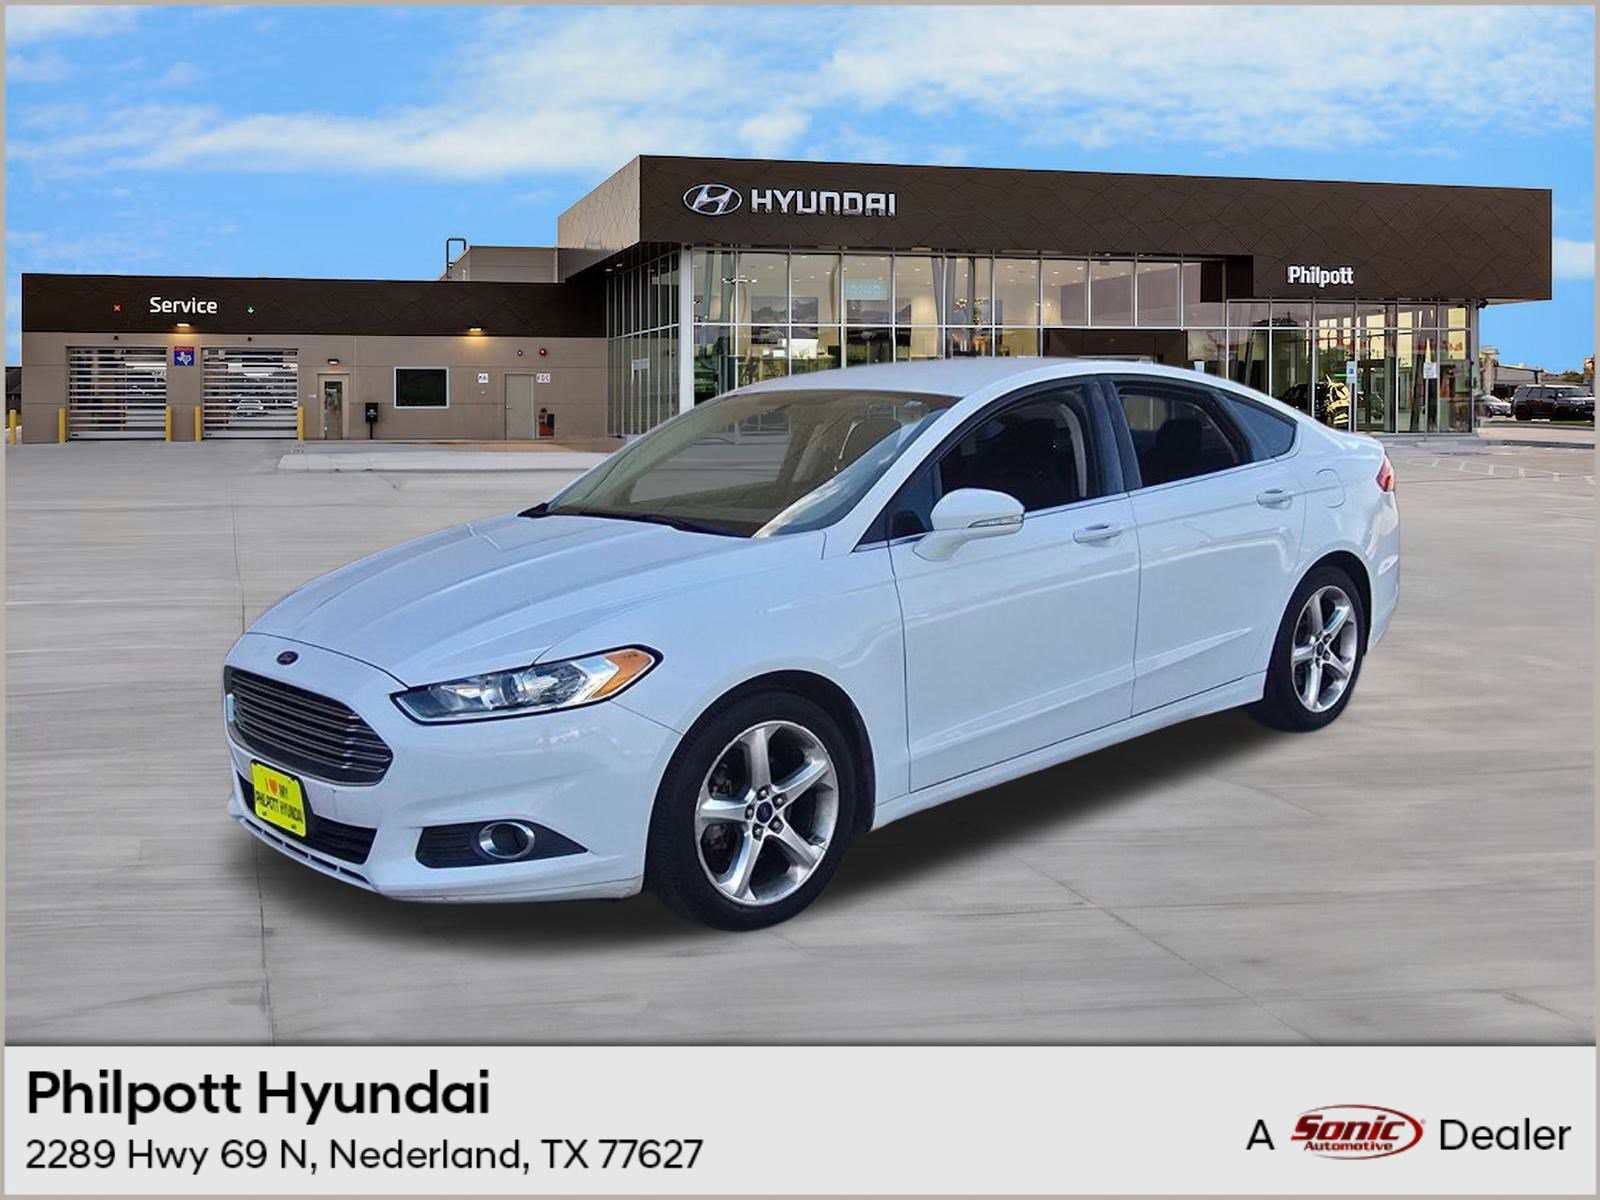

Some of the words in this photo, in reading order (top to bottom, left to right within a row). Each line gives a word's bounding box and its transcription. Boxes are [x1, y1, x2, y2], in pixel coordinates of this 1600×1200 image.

[751, 189, 896, 216] HYUNDAI
[1287, 265, 1354, 288] Philpott
[149, 297, 218, 314] Service
